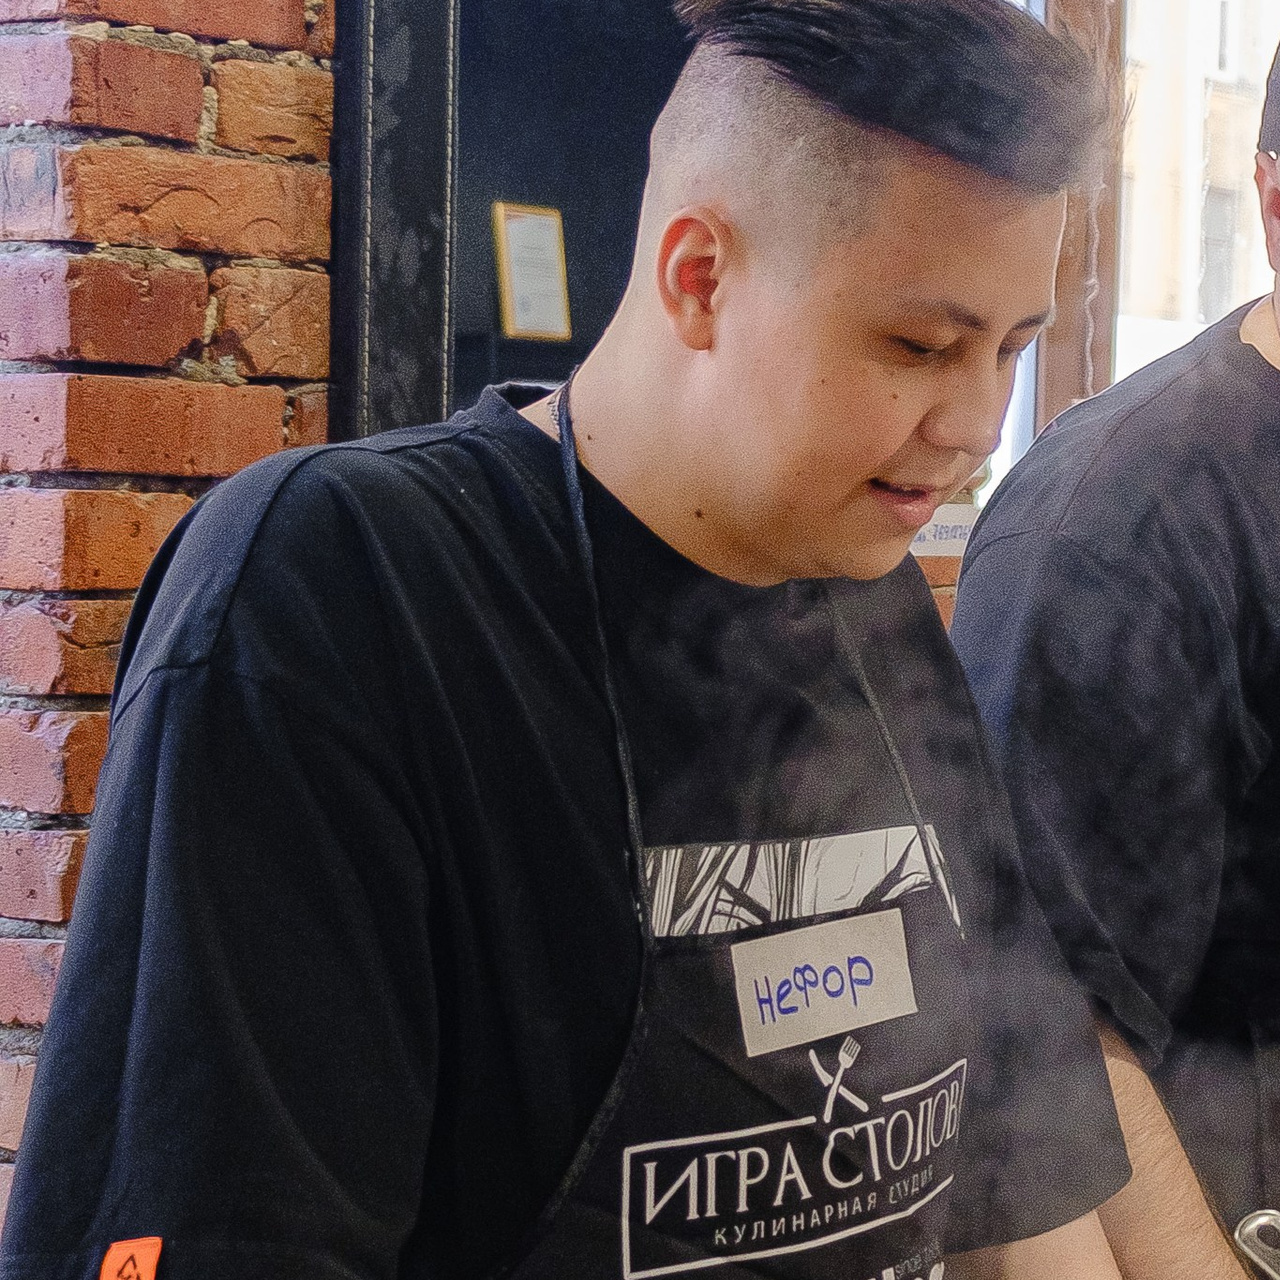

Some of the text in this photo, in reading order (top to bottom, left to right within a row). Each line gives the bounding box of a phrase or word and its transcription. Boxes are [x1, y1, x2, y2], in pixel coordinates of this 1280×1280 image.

[642, 1080, 960, 1225] ИГРА СТОЛОВ
[713, 1191, 877, 1246] КУЛИНАРНАЯ
